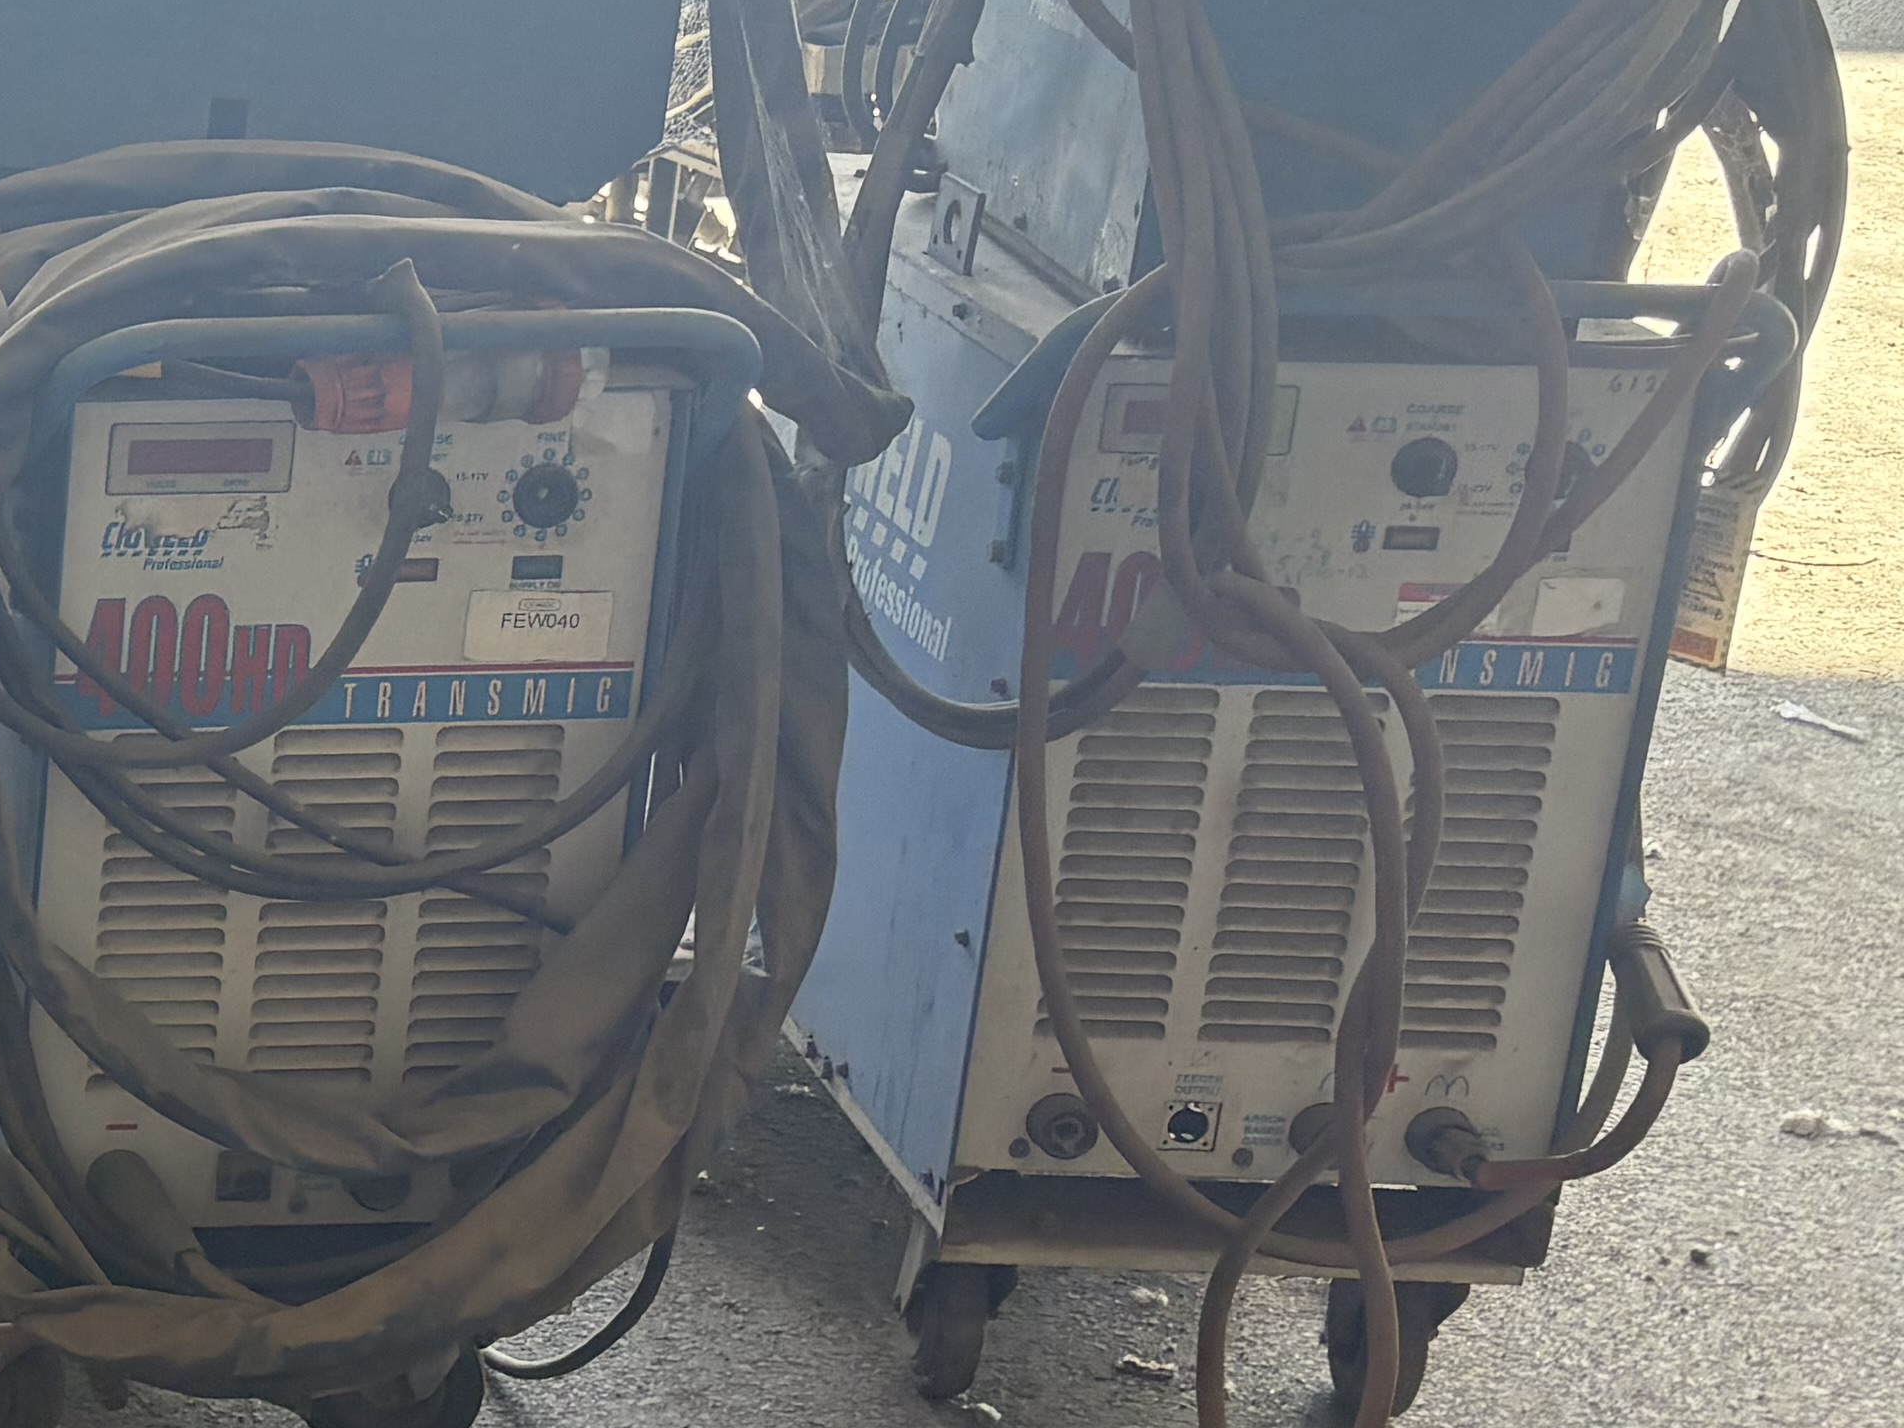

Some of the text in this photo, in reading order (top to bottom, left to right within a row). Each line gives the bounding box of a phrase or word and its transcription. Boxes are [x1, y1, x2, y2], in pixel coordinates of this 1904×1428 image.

[143, 557, 225, 571] Professional
[500, 612, 580, 629] FEW040
[343, 677, 612, 720] TRANSMIG
